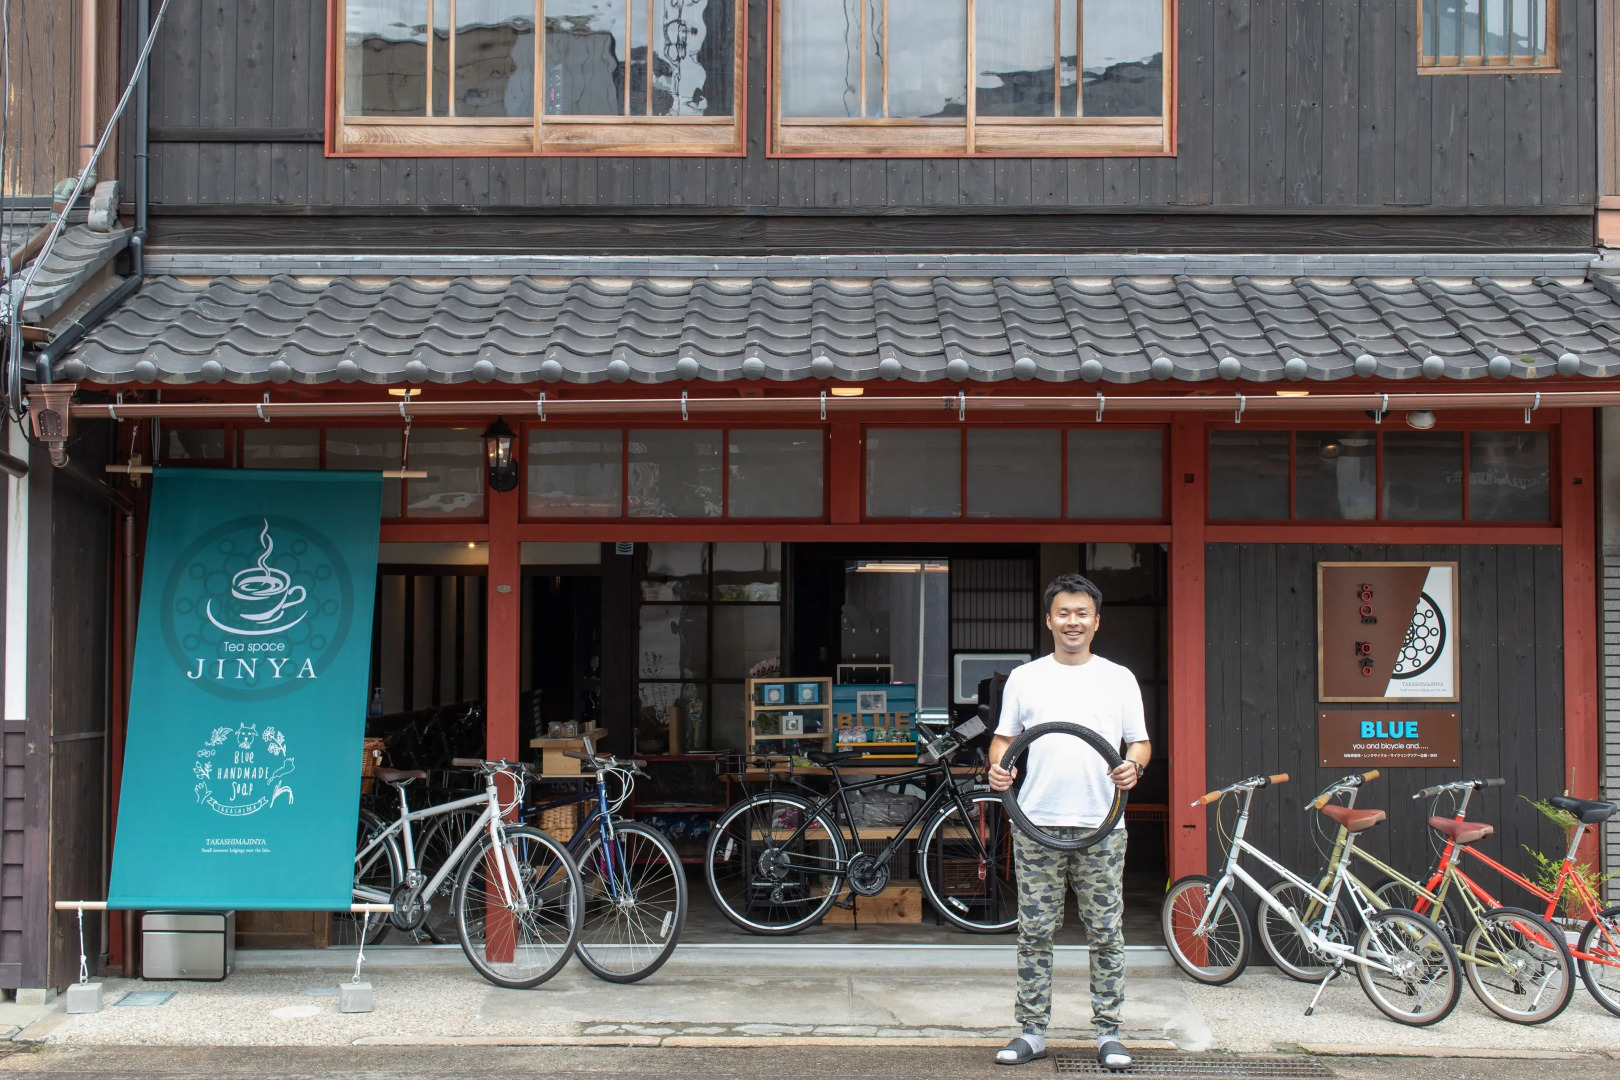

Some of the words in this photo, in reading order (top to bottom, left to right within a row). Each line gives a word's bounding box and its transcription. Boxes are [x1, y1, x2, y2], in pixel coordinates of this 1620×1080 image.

[223, 641, 244, 652] Tea
[247, 642, 285, 653] space
[186, 658, 318, 680] JINYA
[837, 712, 911, 730] BLUE
[1361, 721, 1418, 739] BLUE
[1380, 742, 1405, 750] bicycle
[217, 766, 269, 780] HANDMADE
[205, 838, 267, 846] TAKASHIMAJINYA
